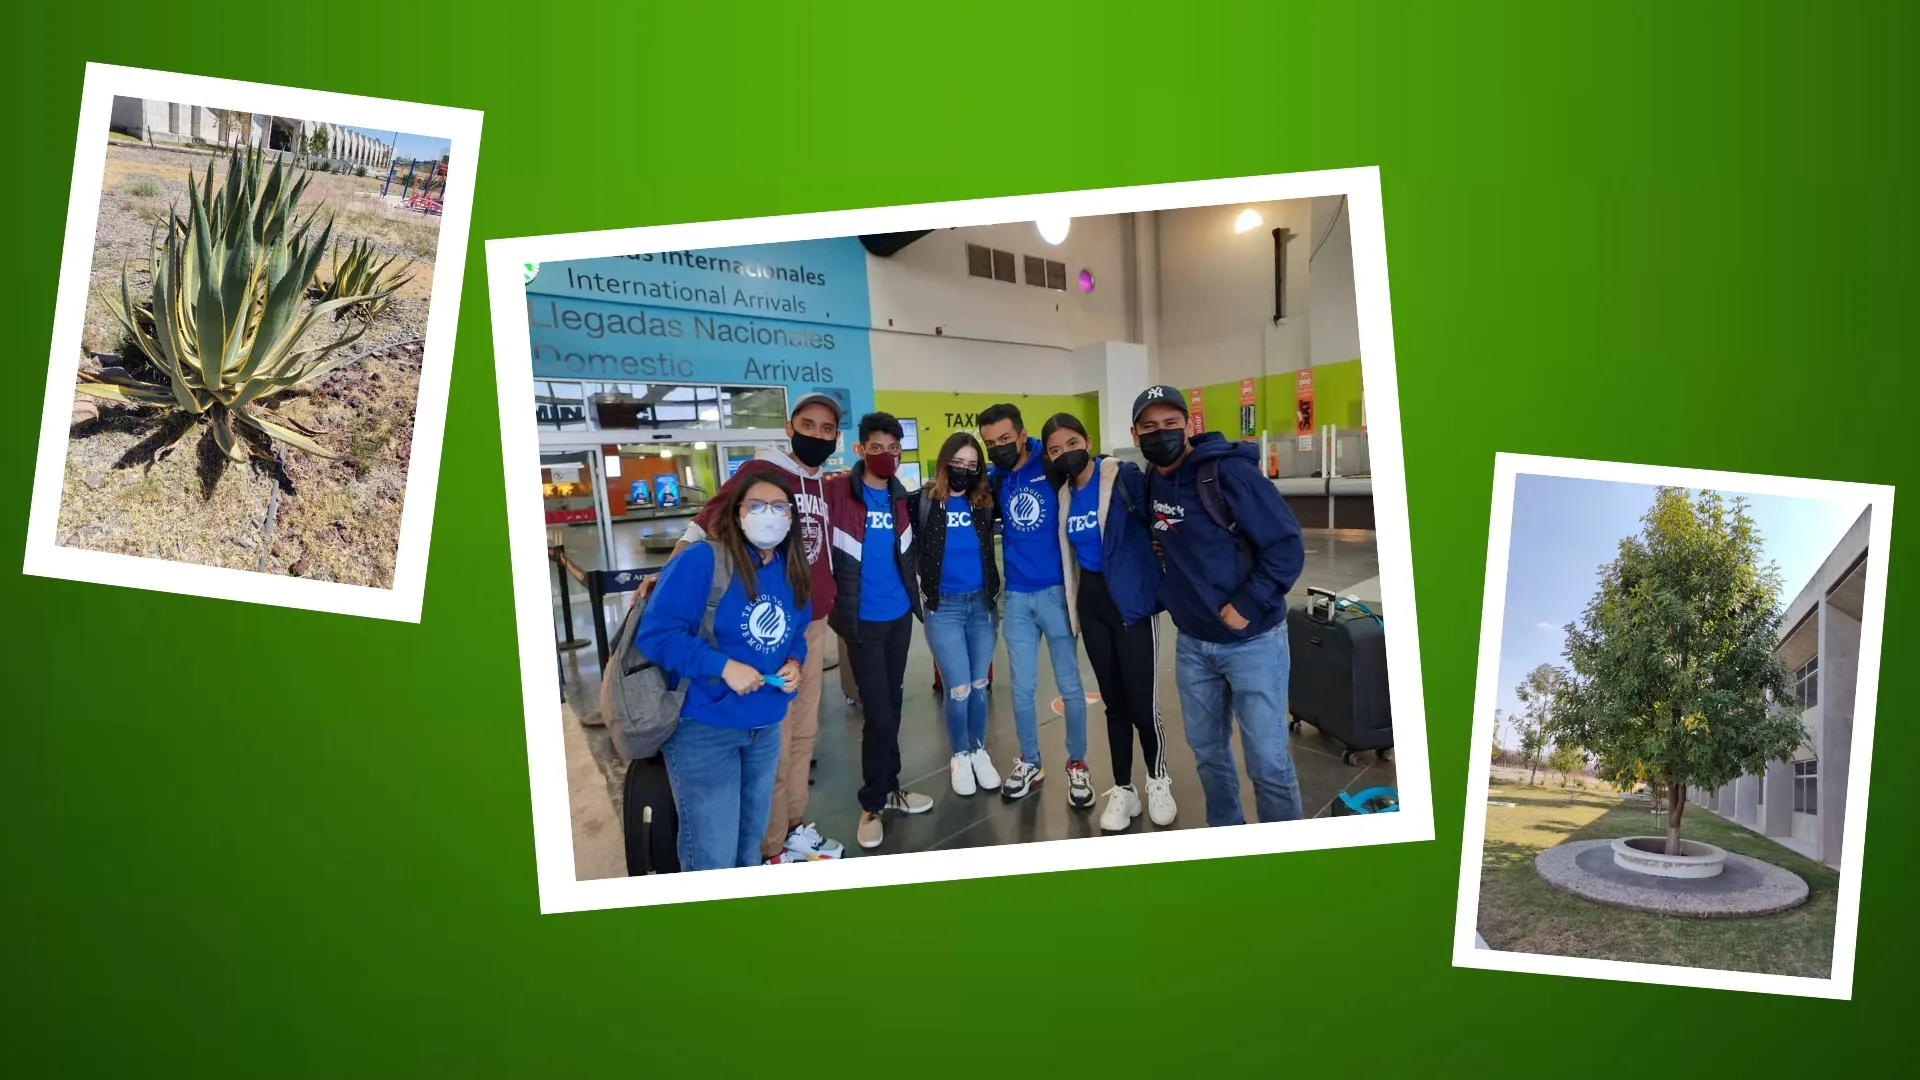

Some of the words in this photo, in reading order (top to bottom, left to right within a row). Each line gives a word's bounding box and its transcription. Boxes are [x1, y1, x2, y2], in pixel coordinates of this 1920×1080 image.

[567, 267, 726, 305] International
[733, 289, 807, 314] Arrivals
[528, 299, 684, 340] Llegadas
[693, 315, 836, 350] Nacionales
[533, 344, 695, 378] Domestic
[743, 357, 834, 383] Arrivals
[1067, 510, 1098, 533] TEC
